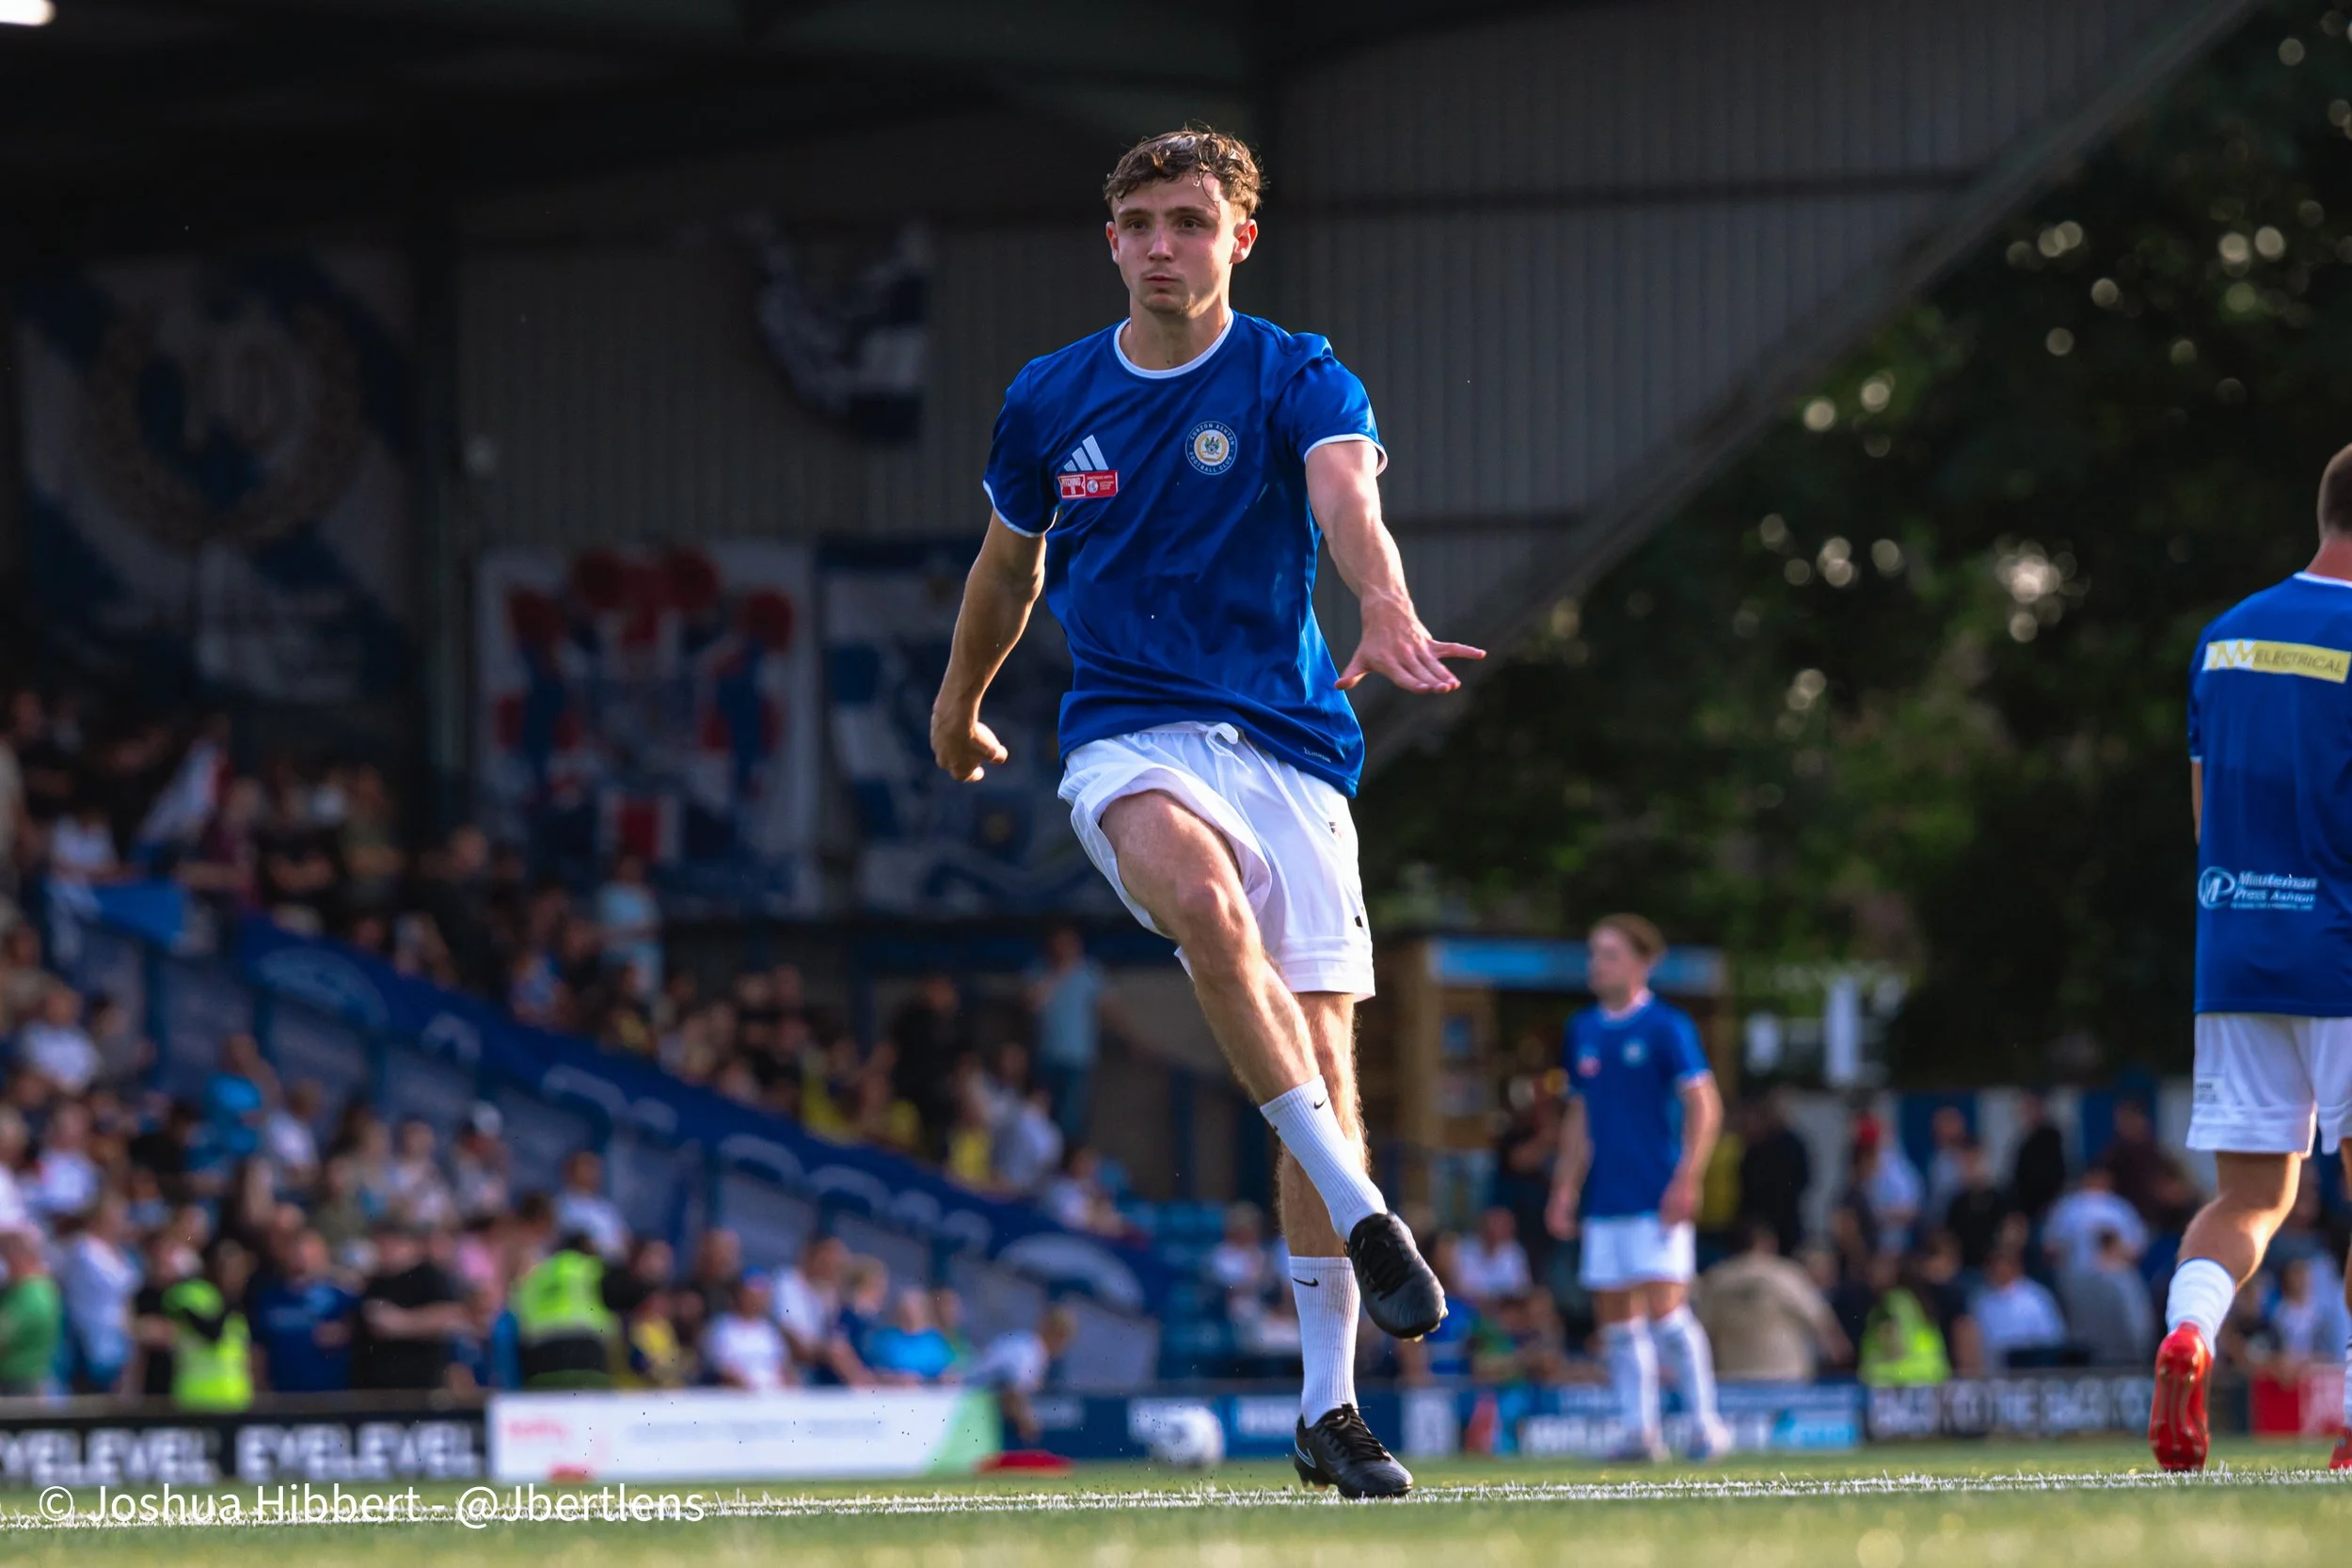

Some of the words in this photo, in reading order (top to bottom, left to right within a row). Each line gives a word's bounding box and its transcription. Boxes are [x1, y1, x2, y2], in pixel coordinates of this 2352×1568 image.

[2254, 649, 2344, 673] ELECTRICAL
[0, 1429, 219, 1484] YELEVEL
[237, 1424, 485, 1480] EYELEVEL
